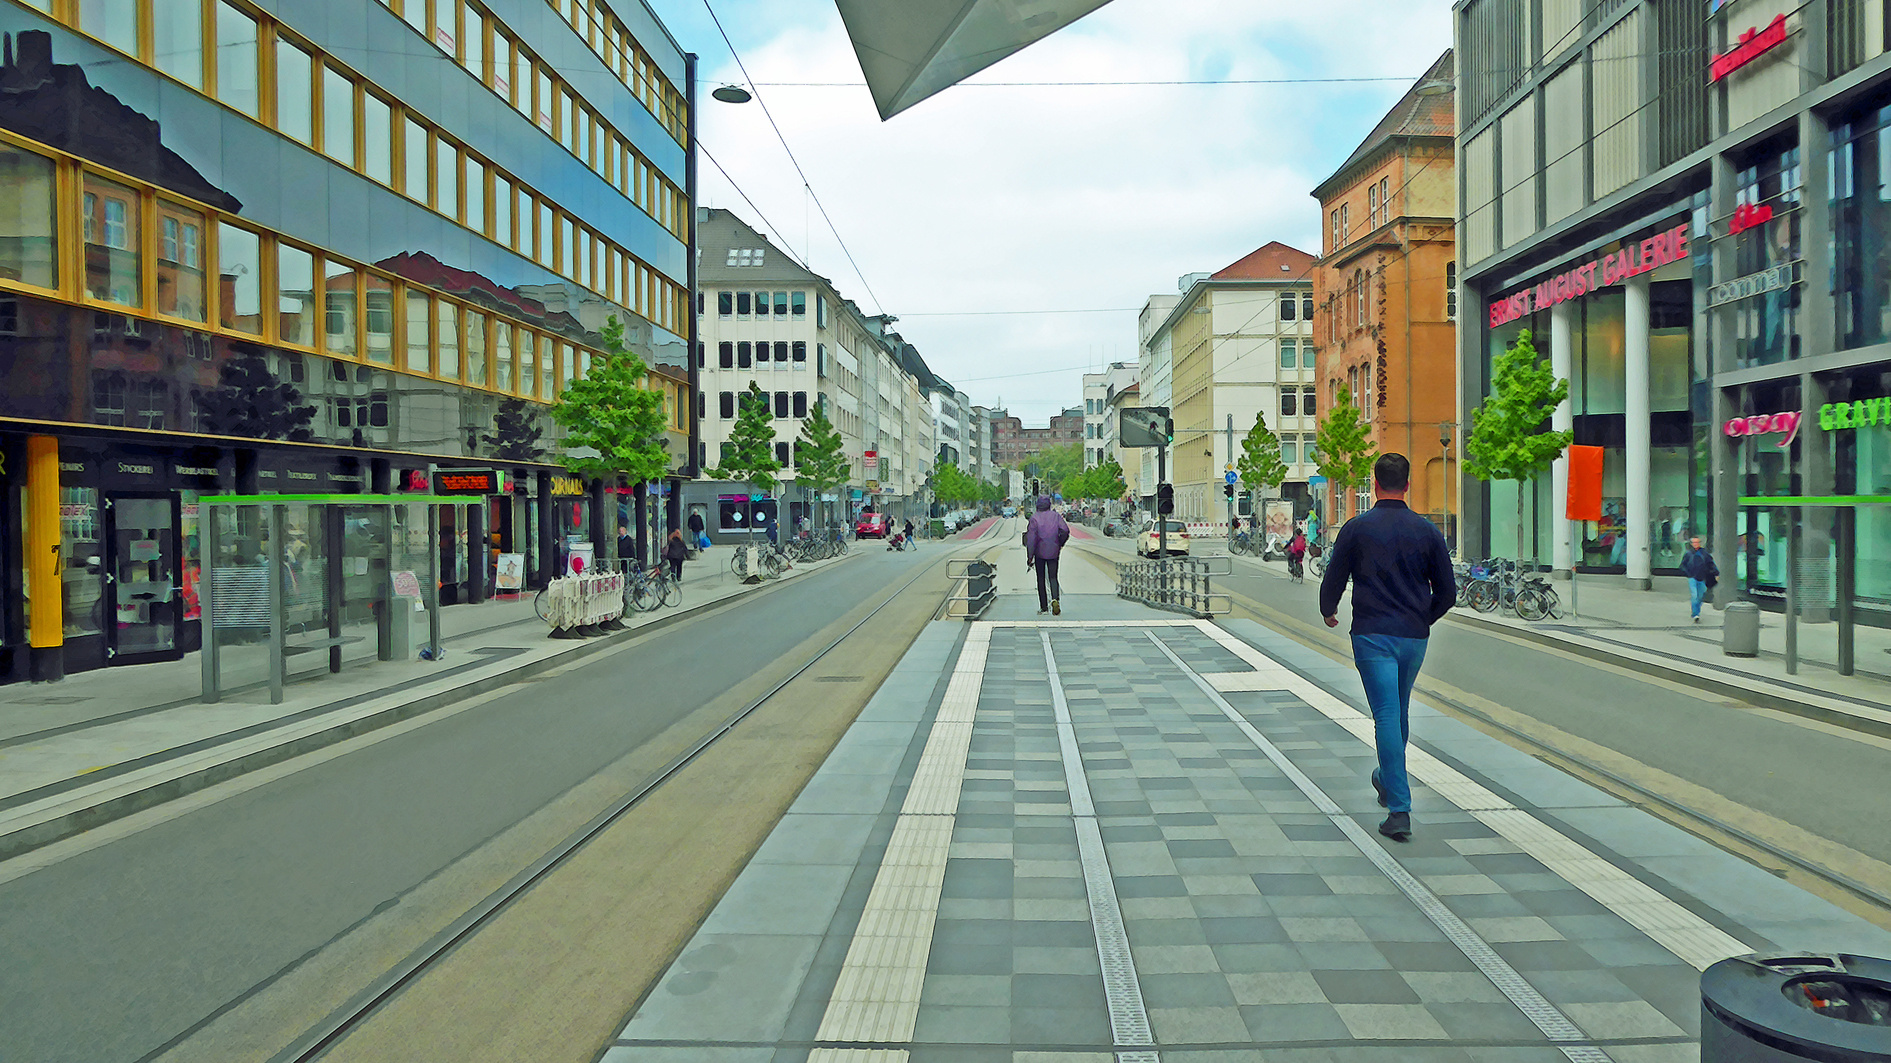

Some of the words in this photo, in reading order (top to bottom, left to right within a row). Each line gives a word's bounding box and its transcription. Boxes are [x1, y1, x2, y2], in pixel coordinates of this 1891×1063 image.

[1489, 288, 1532, 329] ERNST
[1534, 259, 1598, 312] AUGUST
[1602, 222, 1689, 286] GALERIE
[1723, 411, 1803, 448] orsay
